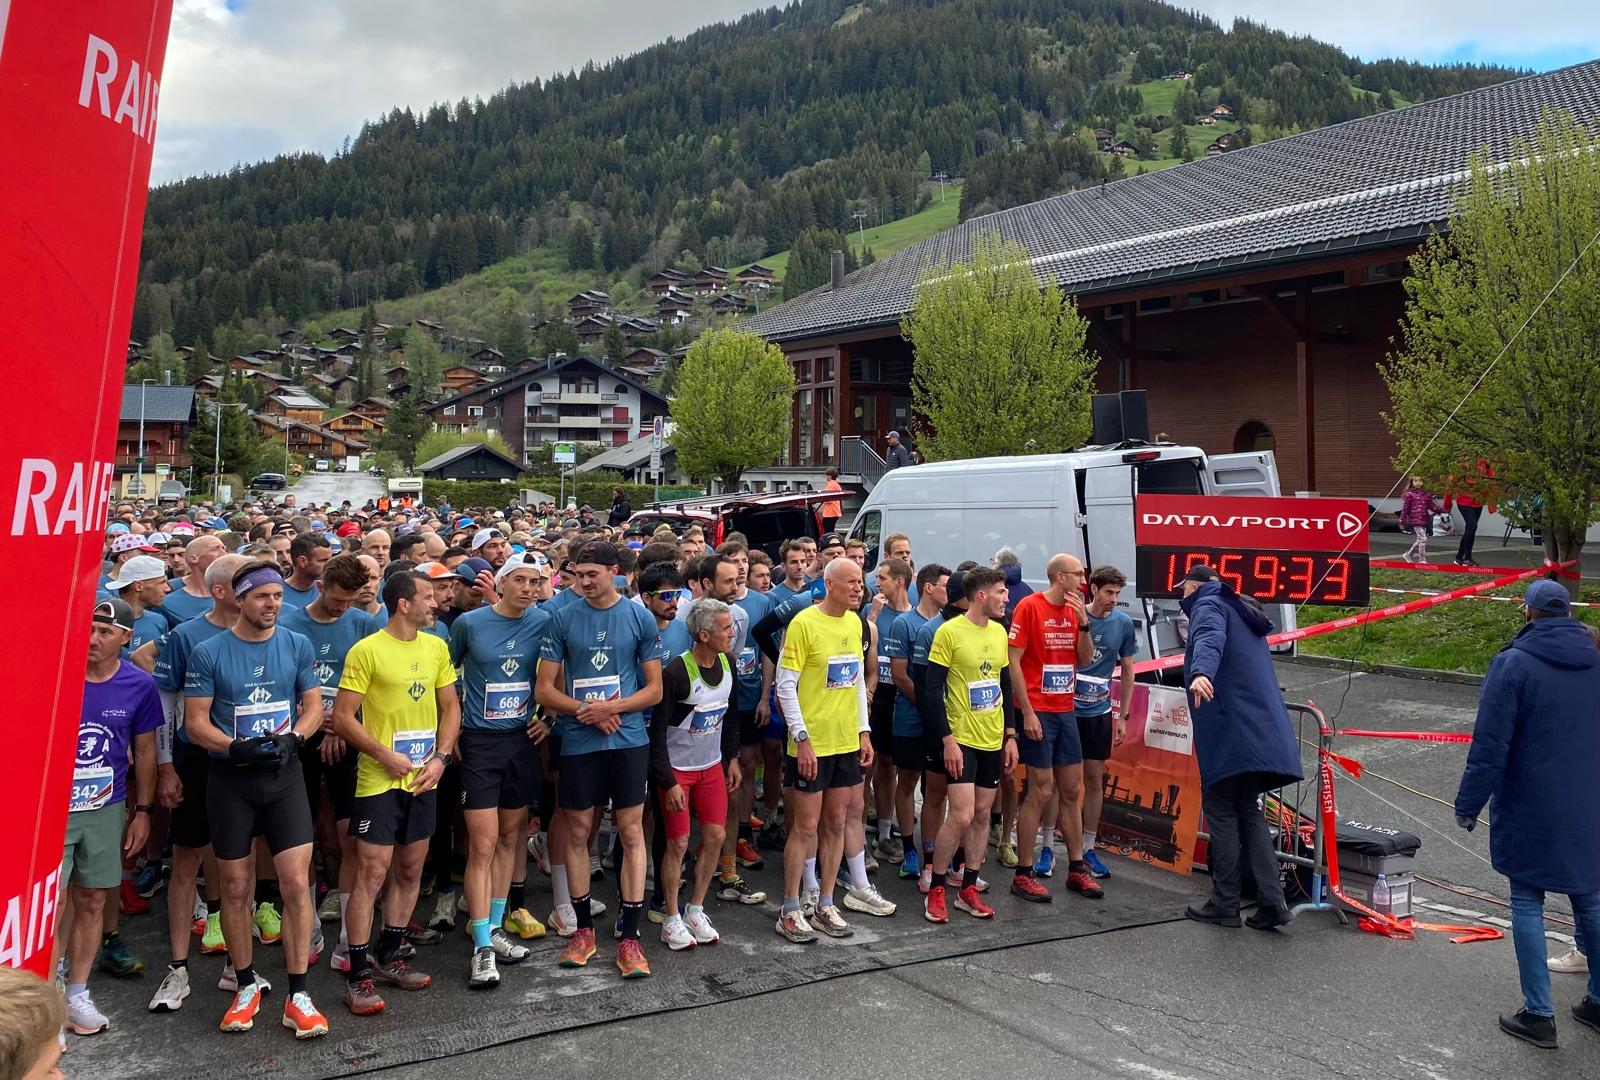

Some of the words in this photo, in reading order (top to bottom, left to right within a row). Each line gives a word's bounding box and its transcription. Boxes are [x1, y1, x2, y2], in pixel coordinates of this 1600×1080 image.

[11, 458, 114, 536] RAIF
[1143, 513, 1330, 530] DATASPORT
[841, 665, 850, 676] 46
[1052, 676, 1069, 686] 1255
[982, 689, 993, 699] 313
[1088, 685, 1098, 693] 25
[500, 697, 520, 709] 668
[252, 718, 275, 733] 431
[704, 715, 720, 727] 708
[410, 743, 425, 754] 201
[72, 784, 98, 799] 342
